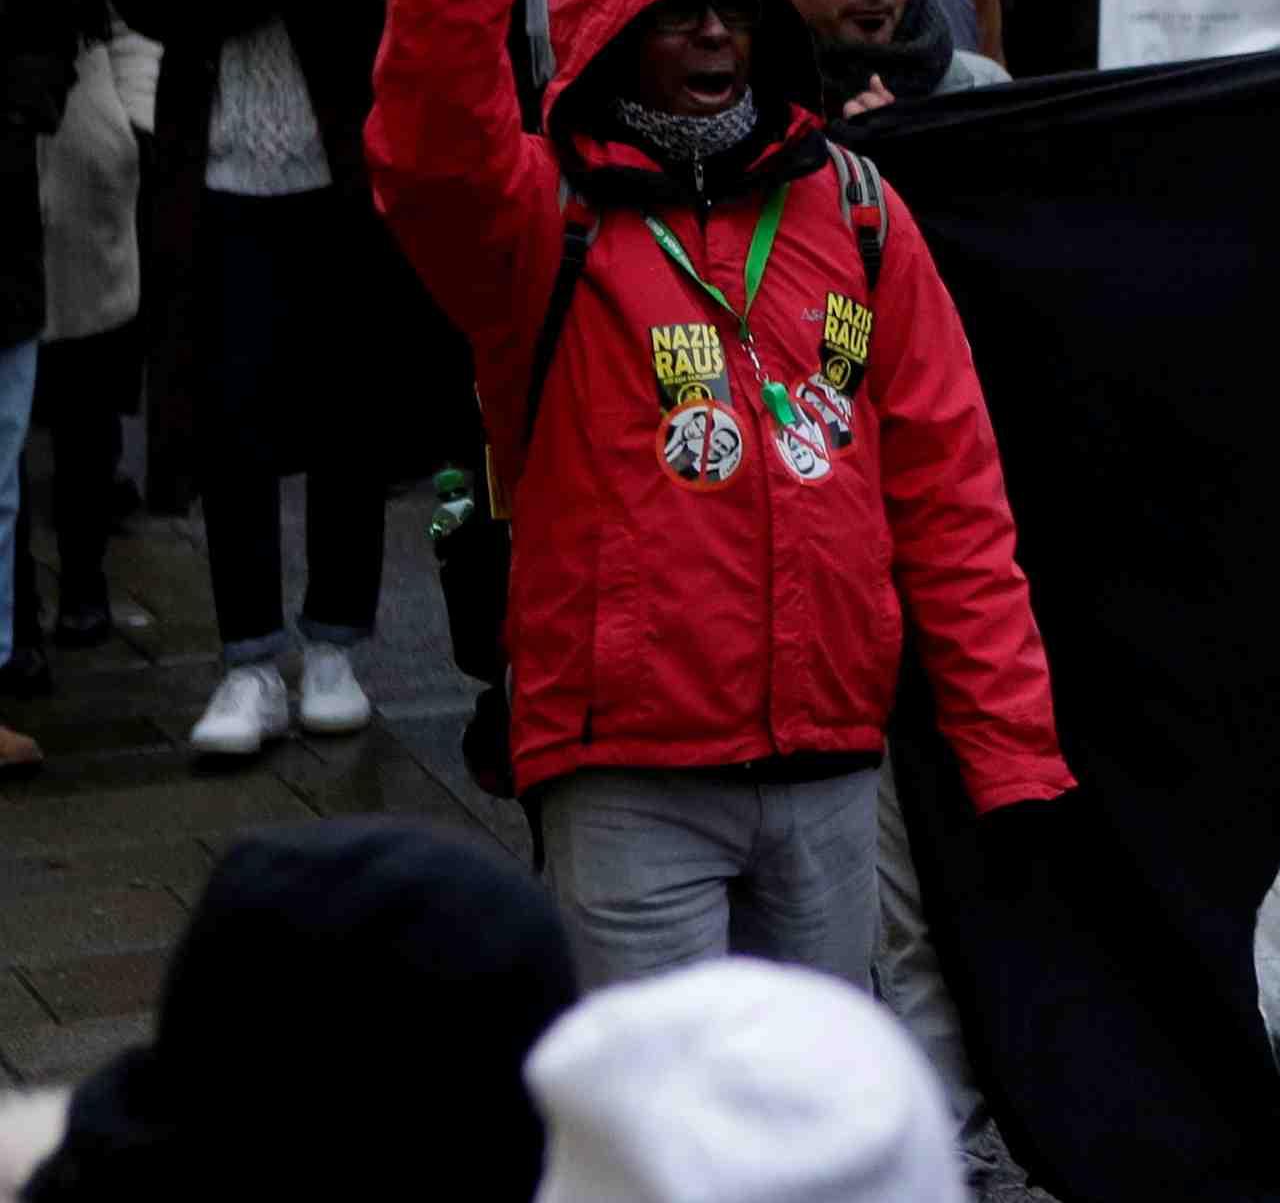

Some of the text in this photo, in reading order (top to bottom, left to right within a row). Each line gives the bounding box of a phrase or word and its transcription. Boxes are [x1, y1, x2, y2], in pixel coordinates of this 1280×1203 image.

[827, 291, 874, 333] NAZIS
[651, 324, 720, 352] NAZIS
[824, 314, 871, 361] RAUS
[654, 347, 725, 380] RAUS
